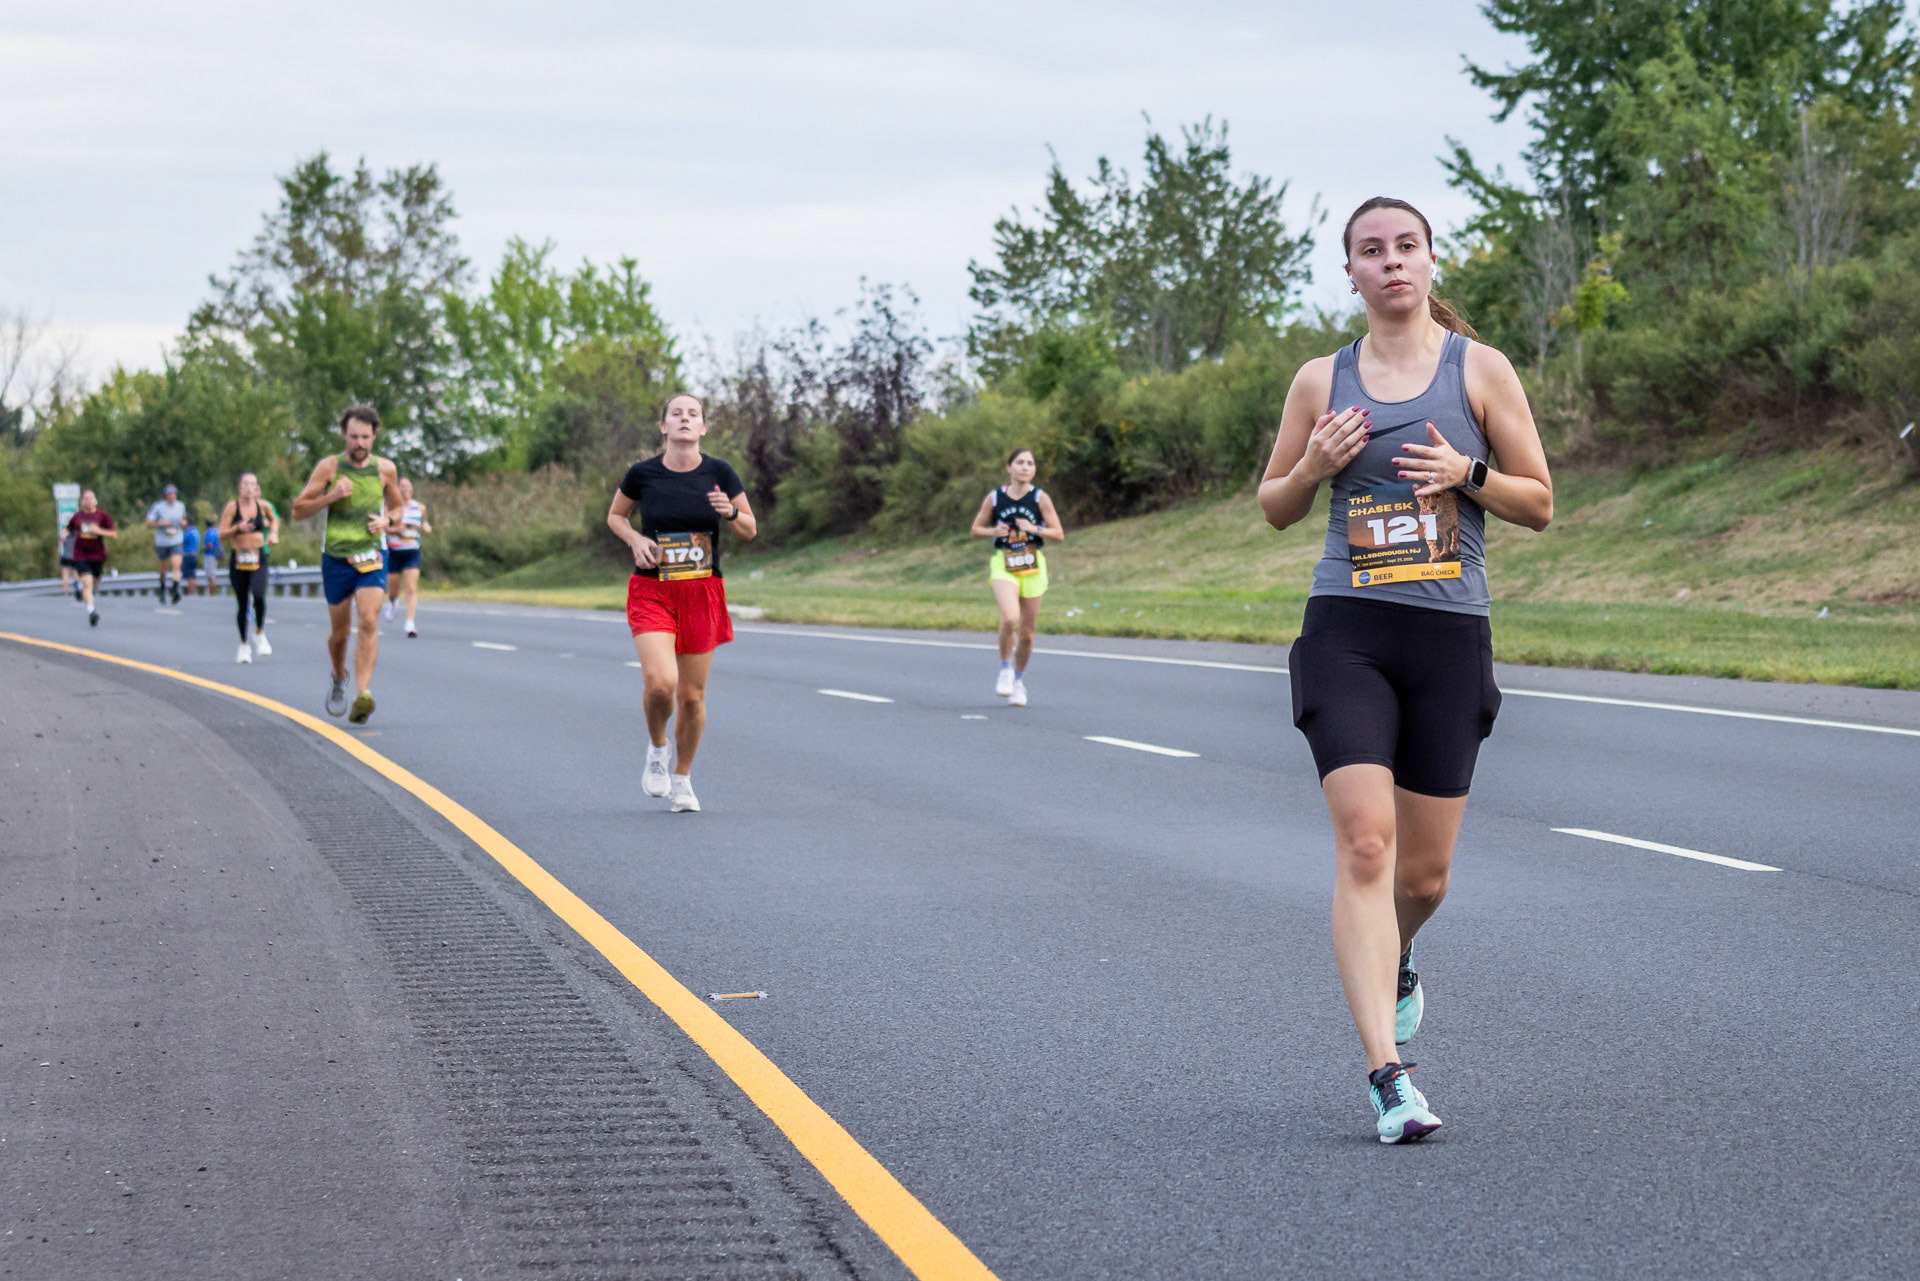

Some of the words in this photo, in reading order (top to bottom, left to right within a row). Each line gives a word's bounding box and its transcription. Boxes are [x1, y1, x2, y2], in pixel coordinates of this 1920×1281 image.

[1349, 495, 1373, 505] THE
[1349, 505, 1392, 517] CHASE
[1394, 502, 1414, 511] 5K
[1367, 514, 1438, 546] 121
[665, 547, 704, 563] 170
[1373, 573, 1394, 581] BEER
